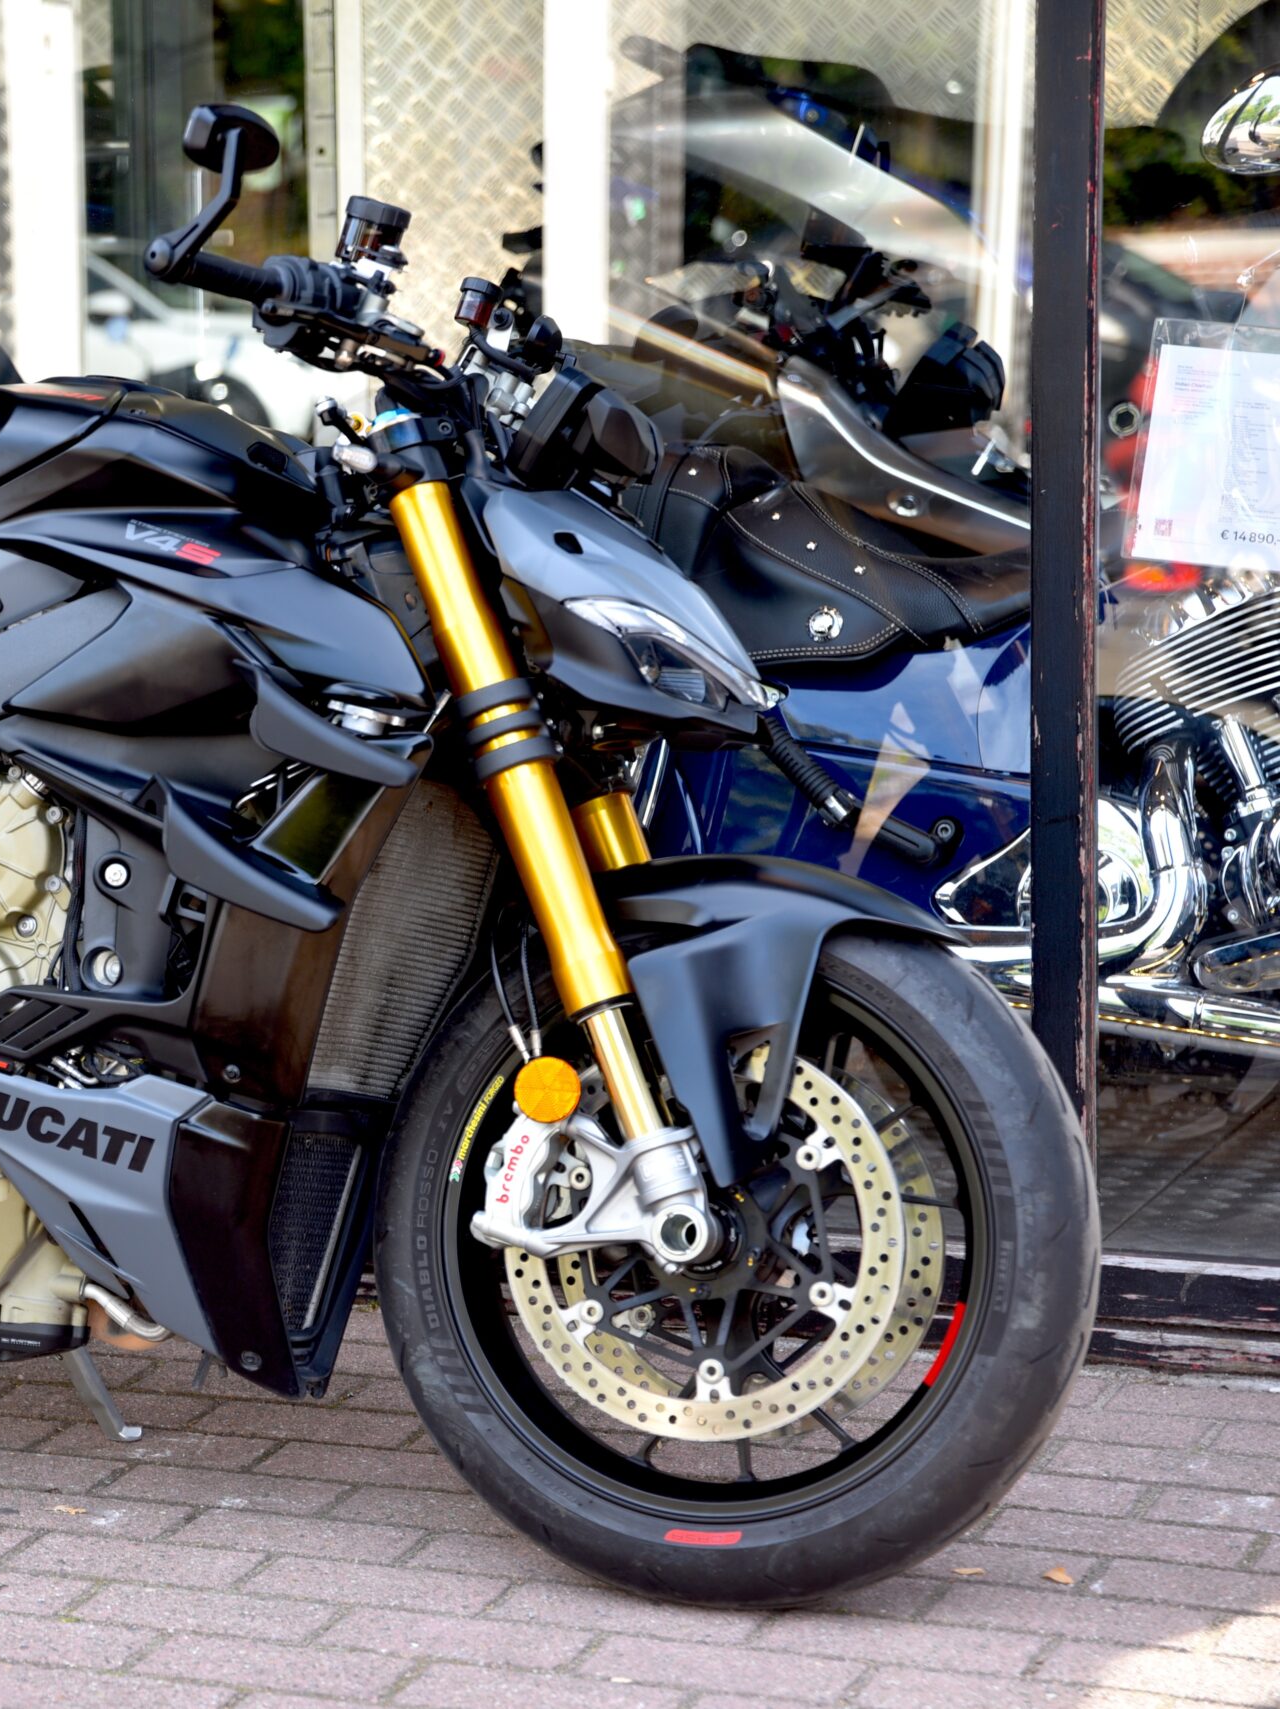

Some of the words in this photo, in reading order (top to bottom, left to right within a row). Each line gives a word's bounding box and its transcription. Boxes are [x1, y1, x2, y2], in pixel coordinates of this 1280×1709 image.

[458, 1102, 488, 1161] marchesini
[484, 1075, 505, 1104] FORGED
[416, 1149, 439, 1228] ROSSO
[417, 1235, 441, 1330] DIABLO
